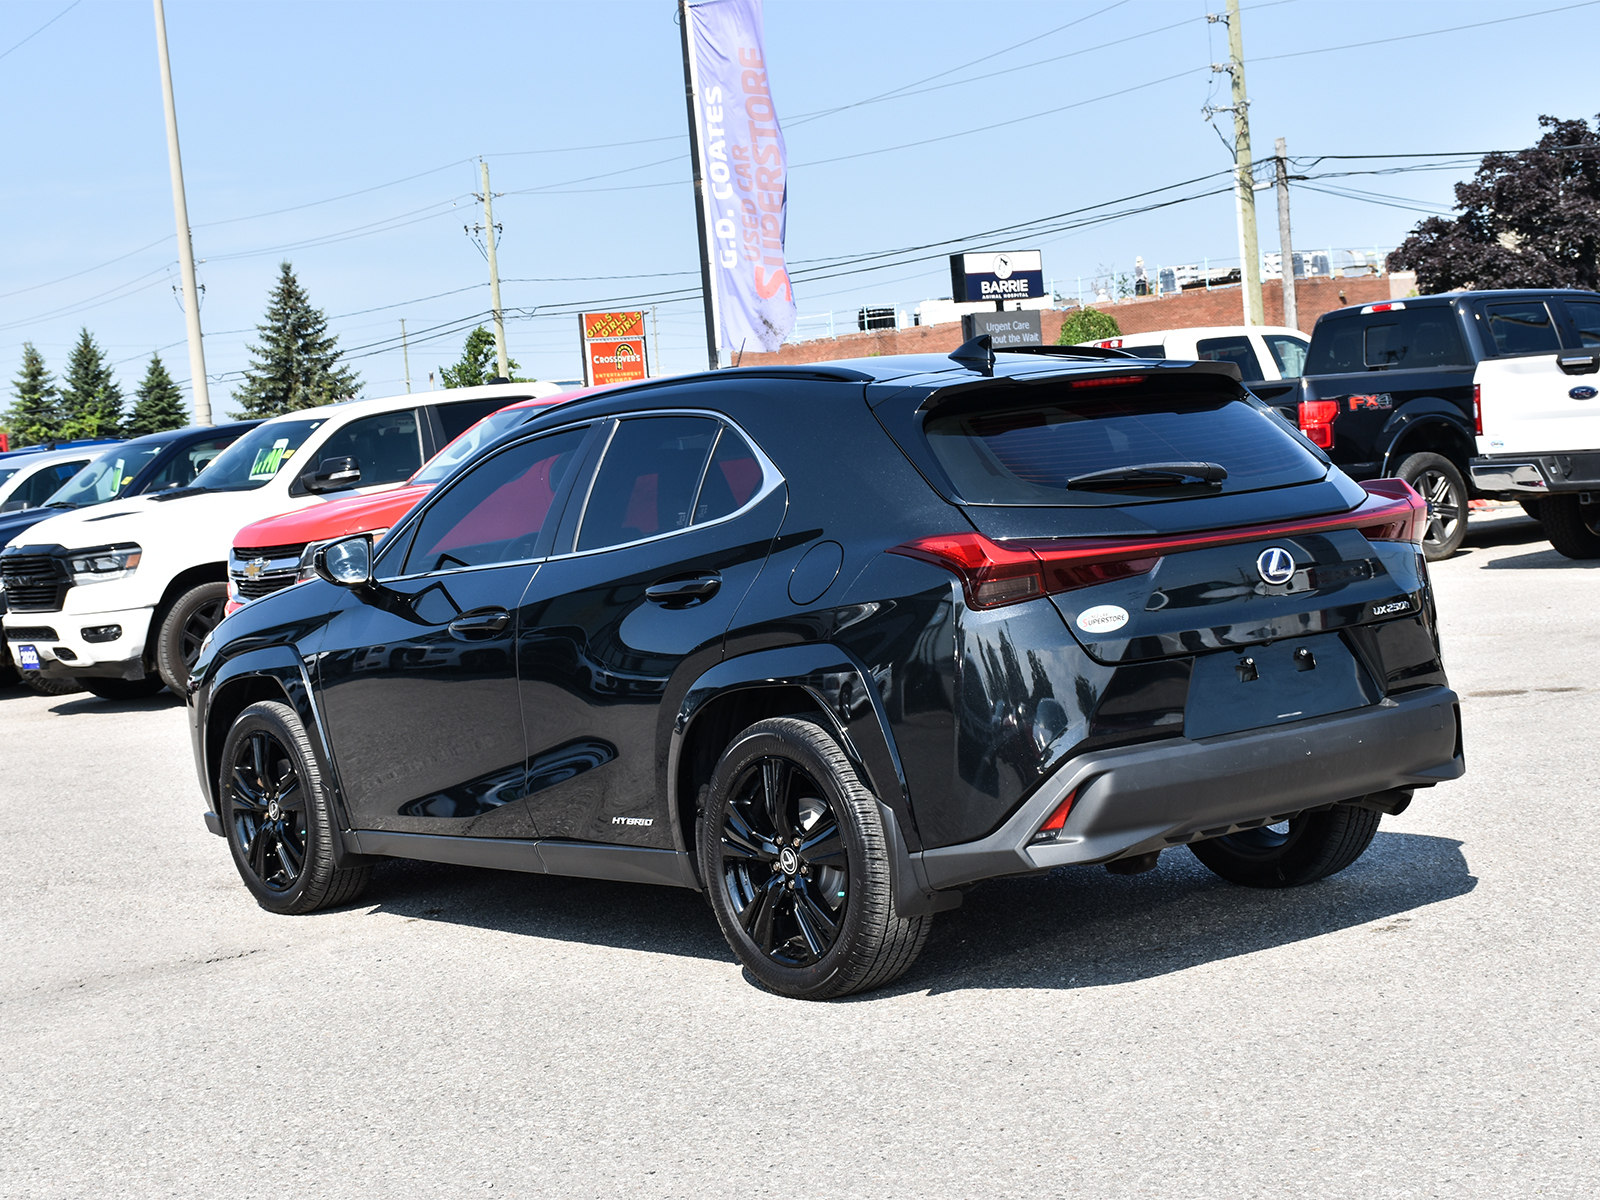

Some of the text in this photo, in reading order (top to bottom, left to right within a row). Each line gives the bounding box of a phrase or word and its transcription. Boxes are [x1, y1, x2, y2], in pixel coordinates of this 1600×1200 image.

[705, 86, 738, 269] G.D. COATES
[738, 47, 792, 302] SUPERSTORE
[731, 144, 761, 262] USED CAR
[980, 279, 1029, 294] BARRIE
[586, 313, 613, 338] GIRLS
[601, 312, 627, 337] GIRLS
[616, 311, 642, 337] GIRLS
[986, 320, 1030, 333] Urgent Care
[1008, 333, 1021, 343] the
[1021, 332, 1039, 342] Wait
[595, 371, 642, 379] ENTERTAINMENT
[1348, 393, 1393, 411] FX4
[1082, 613, 1125, 628] SUPERSTORE
[611, 816, 654, 826] HYBRID
